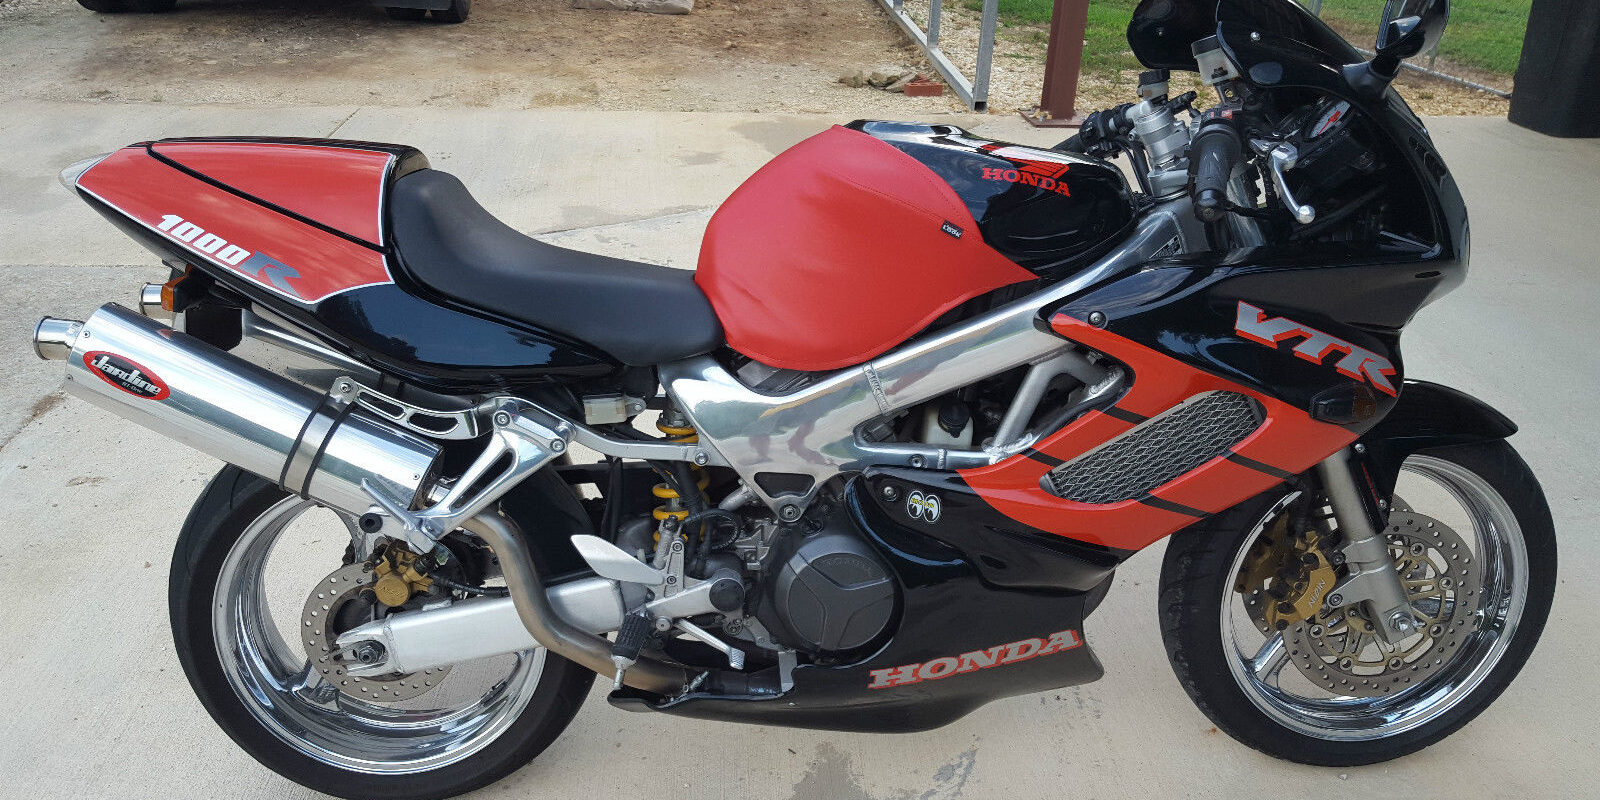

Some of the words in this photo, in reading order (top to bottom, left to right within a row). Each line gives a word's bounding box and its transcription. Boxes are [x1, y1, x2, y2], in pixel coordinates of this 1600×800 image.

[981, 167, 1071, 197] HONDA
[157, 214, 301, 298] 1000R
[91, 356, 162, 395] Jardine
[1235, 300, 1397, 398] VTR
[867, 629, 1083, 690] HONDA
